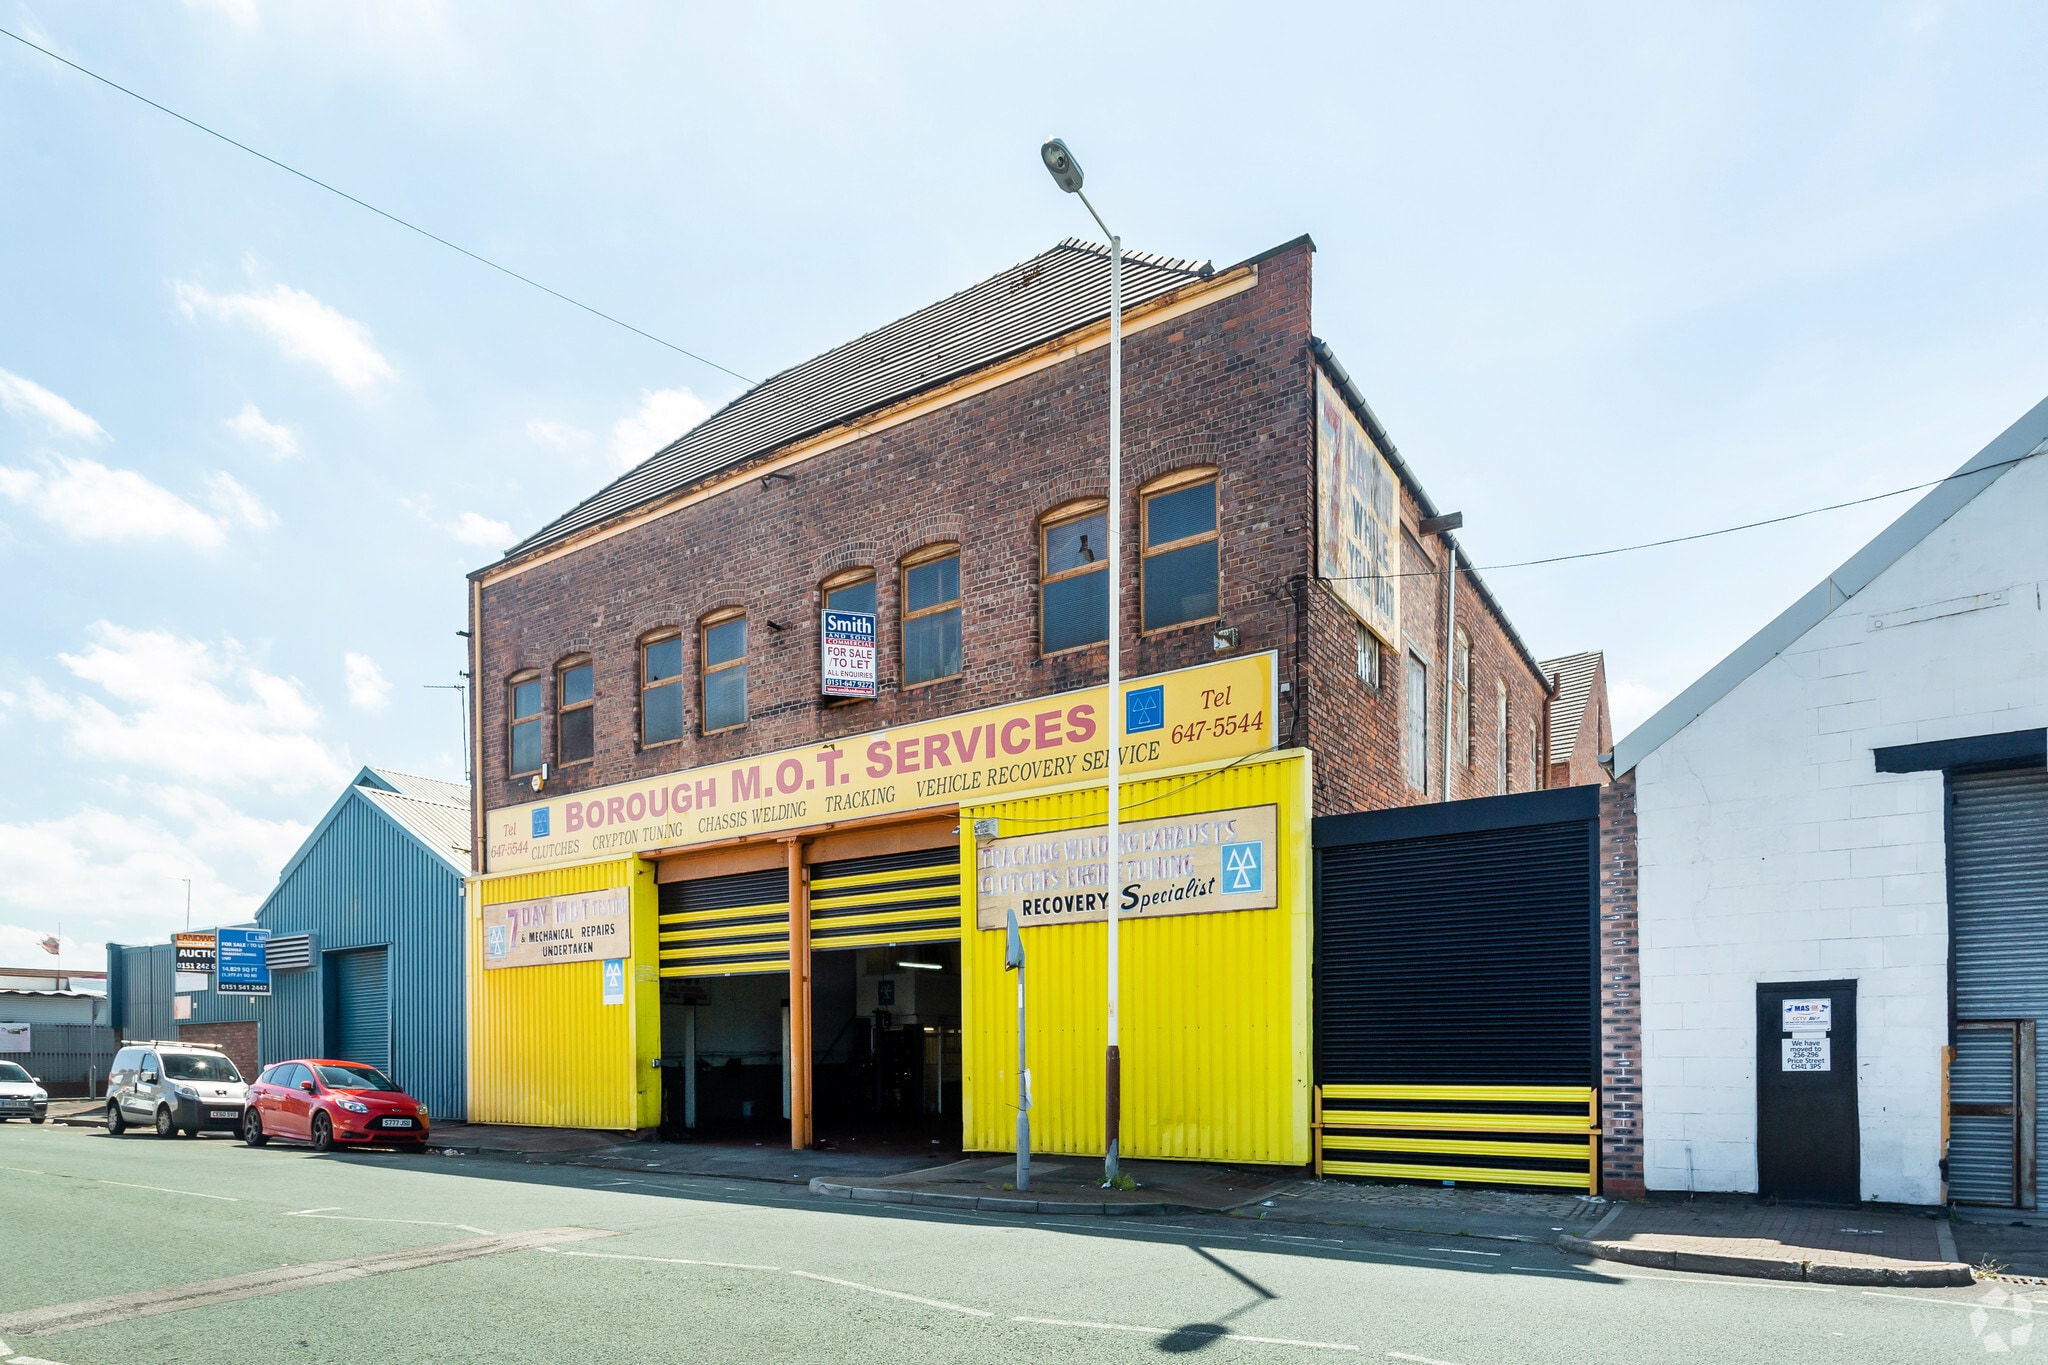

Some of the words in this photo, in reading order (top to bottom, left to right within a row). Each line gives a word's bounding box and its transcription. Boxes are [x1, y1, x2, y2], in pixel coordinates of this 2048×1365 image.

[828, 615, 872, 634] Smith
[828, 640, 873, 648] COMMERCIAL
[828, 647, 846, 656] FOR
[849, 648, 872, 660] SALE
[850, 660, 870, 669] LET
[840, 671, 874, 679] ENQUIRIES
[1201, 686, 1232, 710] Tel
[1171, 710, 1263, 745] 647-5544
[566, 778, 717, 832] BOROUGH
[732, 750, 850, 803] M.O.T.
[866, 704, 1097, 779] SERVICES
[532, 840, 580, 860] CLUTCHES
[592, 830, 639, 850] CRYPTON
[642, 822, 684, 842] TUNING
[698, 811, 748, 834] CHASSIS
[752, 800, 808, 824] WELDING
[825, 786, 896, 813] TRACKING
[916, 771, 982, 798] VEHICLE
[986, 754, 1078, 787] RECOVERY
[504, 822, 517, 837] Tel
[490, 840, 528, 858] 647-5544
[982, 842, 1060, 870] TRACKING
[1064, 831, 1139, 861] WELDNG
[1143, 820, 1238, 853] EXHAUSTS
[981, 867, 1061, 896] CLUTCHES
[1126, 854, 1195, 882] TUNING
[1022, 892, 1109, 916] RECOVERY
[1120, 877, 1216, 913] Specialist
[506, 908, 518, 952] 7
[521, 904, 548, 928] DAY
[528, 928, 574, 942] MECHANICAL
[582, 924, 615, 938] REPAIRS
[542, 942, 594, 957] UNDERTAKEN
[196, 962, 210, 970] 242
